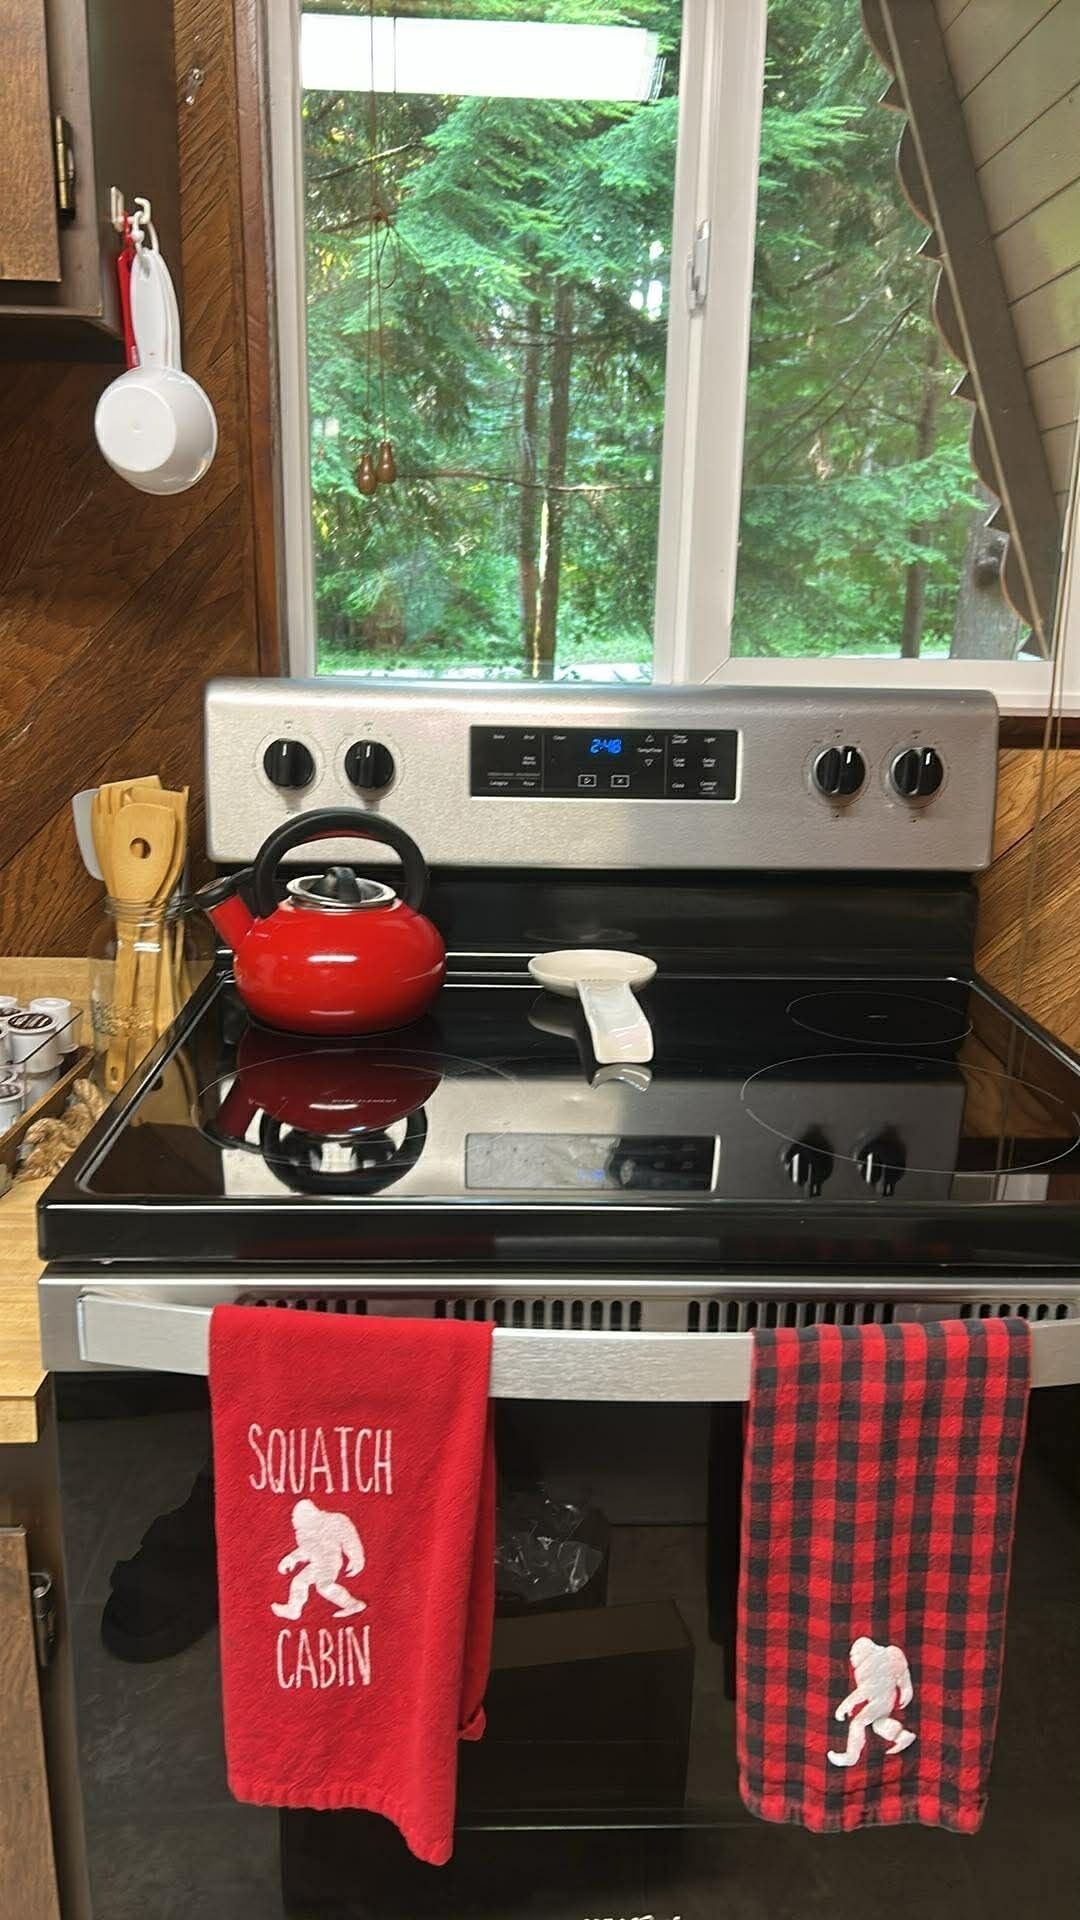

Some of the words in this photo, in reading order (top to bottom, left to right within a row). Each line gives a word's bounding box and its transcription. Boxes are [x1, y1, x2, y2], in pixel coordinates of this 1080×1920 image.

[590, 738, 622, 754] 2:48
[248, 1423, 393, 1495] SQUATCH
[276, 1625, 372, 1689] CABIN
